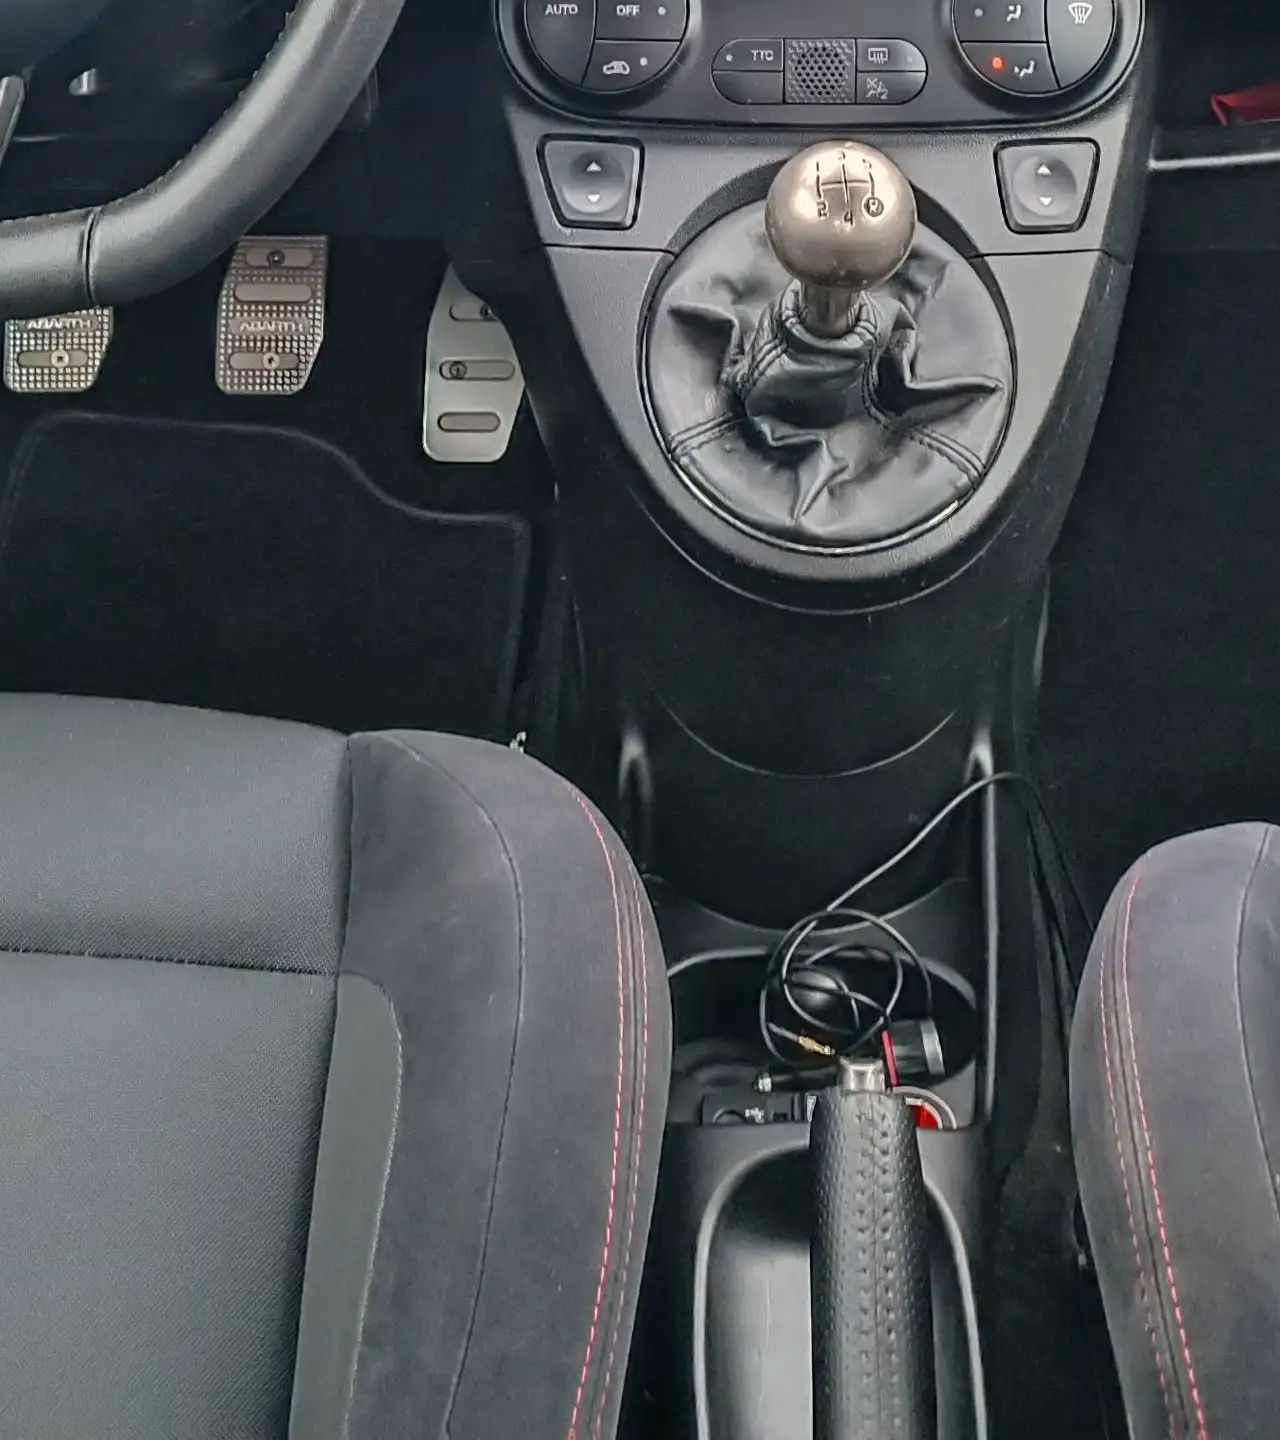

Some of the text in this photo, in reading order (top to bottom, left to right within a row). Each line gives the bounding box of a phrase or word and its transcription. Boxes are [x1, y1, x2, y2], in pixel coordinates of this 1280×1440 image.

[545, 3, 579, 16] AUTO
[616, 4, 641, 17] OFF
[750, 49, 774, 61] TTC
[816, 201, 828, 218] 2
[843, 209, 854, 226] 4
